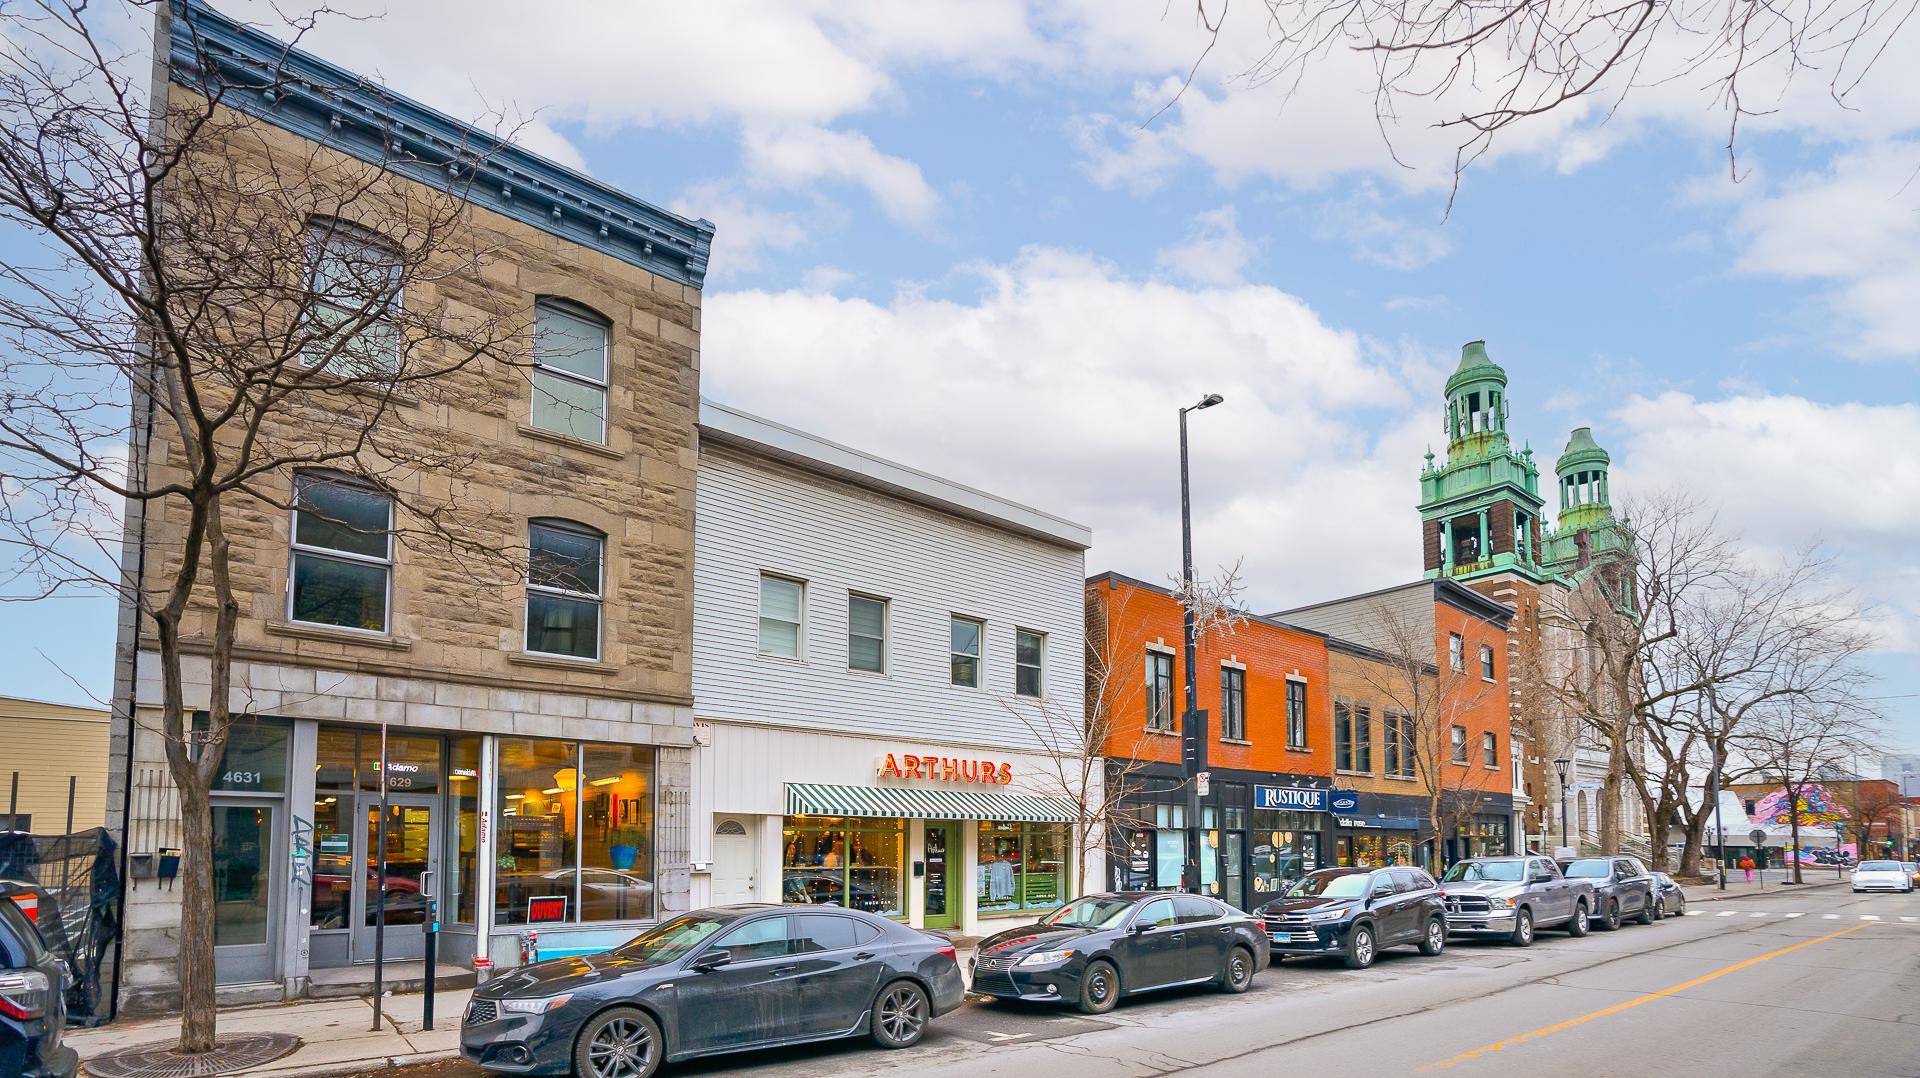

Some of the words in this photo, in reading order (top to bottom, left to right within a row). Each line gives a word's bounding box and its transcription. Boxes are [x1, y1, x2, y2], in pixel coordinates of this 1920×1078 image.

[222, 771, 262, 784] 4631
[878, 753, 1012, 785] ARTHURS
[389, 777, 412, 787] 629
[1264, 788, 1321, 809] RUSTIQUE
[531, 901, 564, 920] OUVERT
